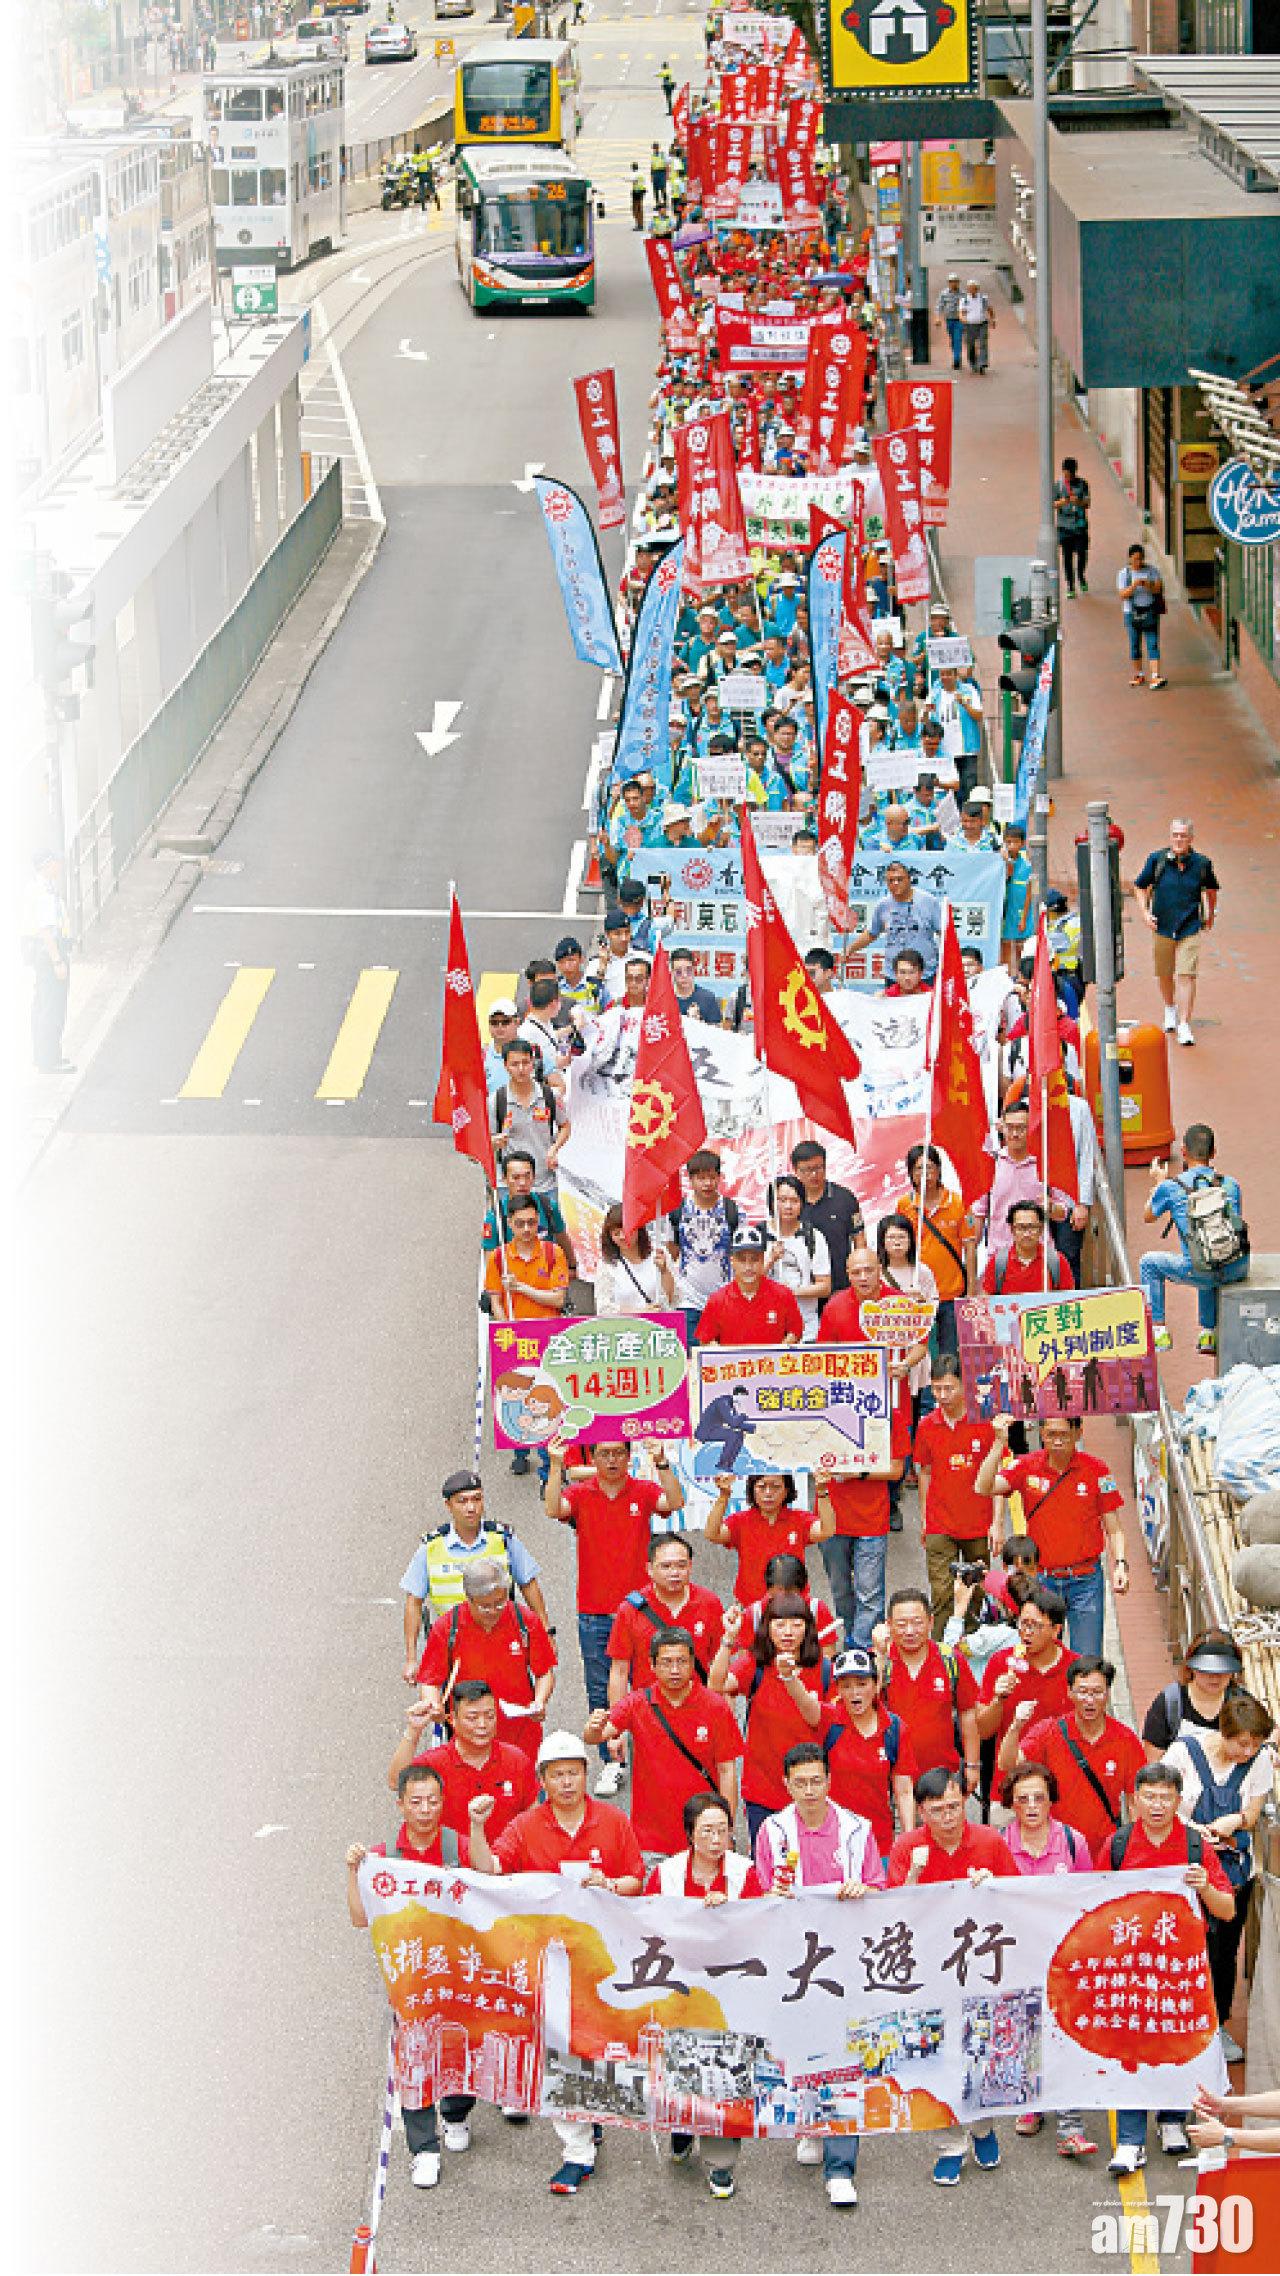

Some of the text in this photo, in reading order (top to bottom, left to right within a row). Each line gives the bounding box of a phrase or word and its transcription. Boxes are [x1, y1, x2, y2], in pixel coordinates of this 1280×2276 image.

[1024, 1302, 1084, 1338] 反對
[546, 1329, 679, 1366] 全薪產假
[1038, 1319, 1141, 1366] 外判制度
[564, 1365, 667, 1401] 14週!!
[1109, 1910, 1180, 1947] 訴求
[613, 1915, 1018, 1997] 五一大遊行
[1068, 1950, 1208, 1974] 立即取消強積金對
